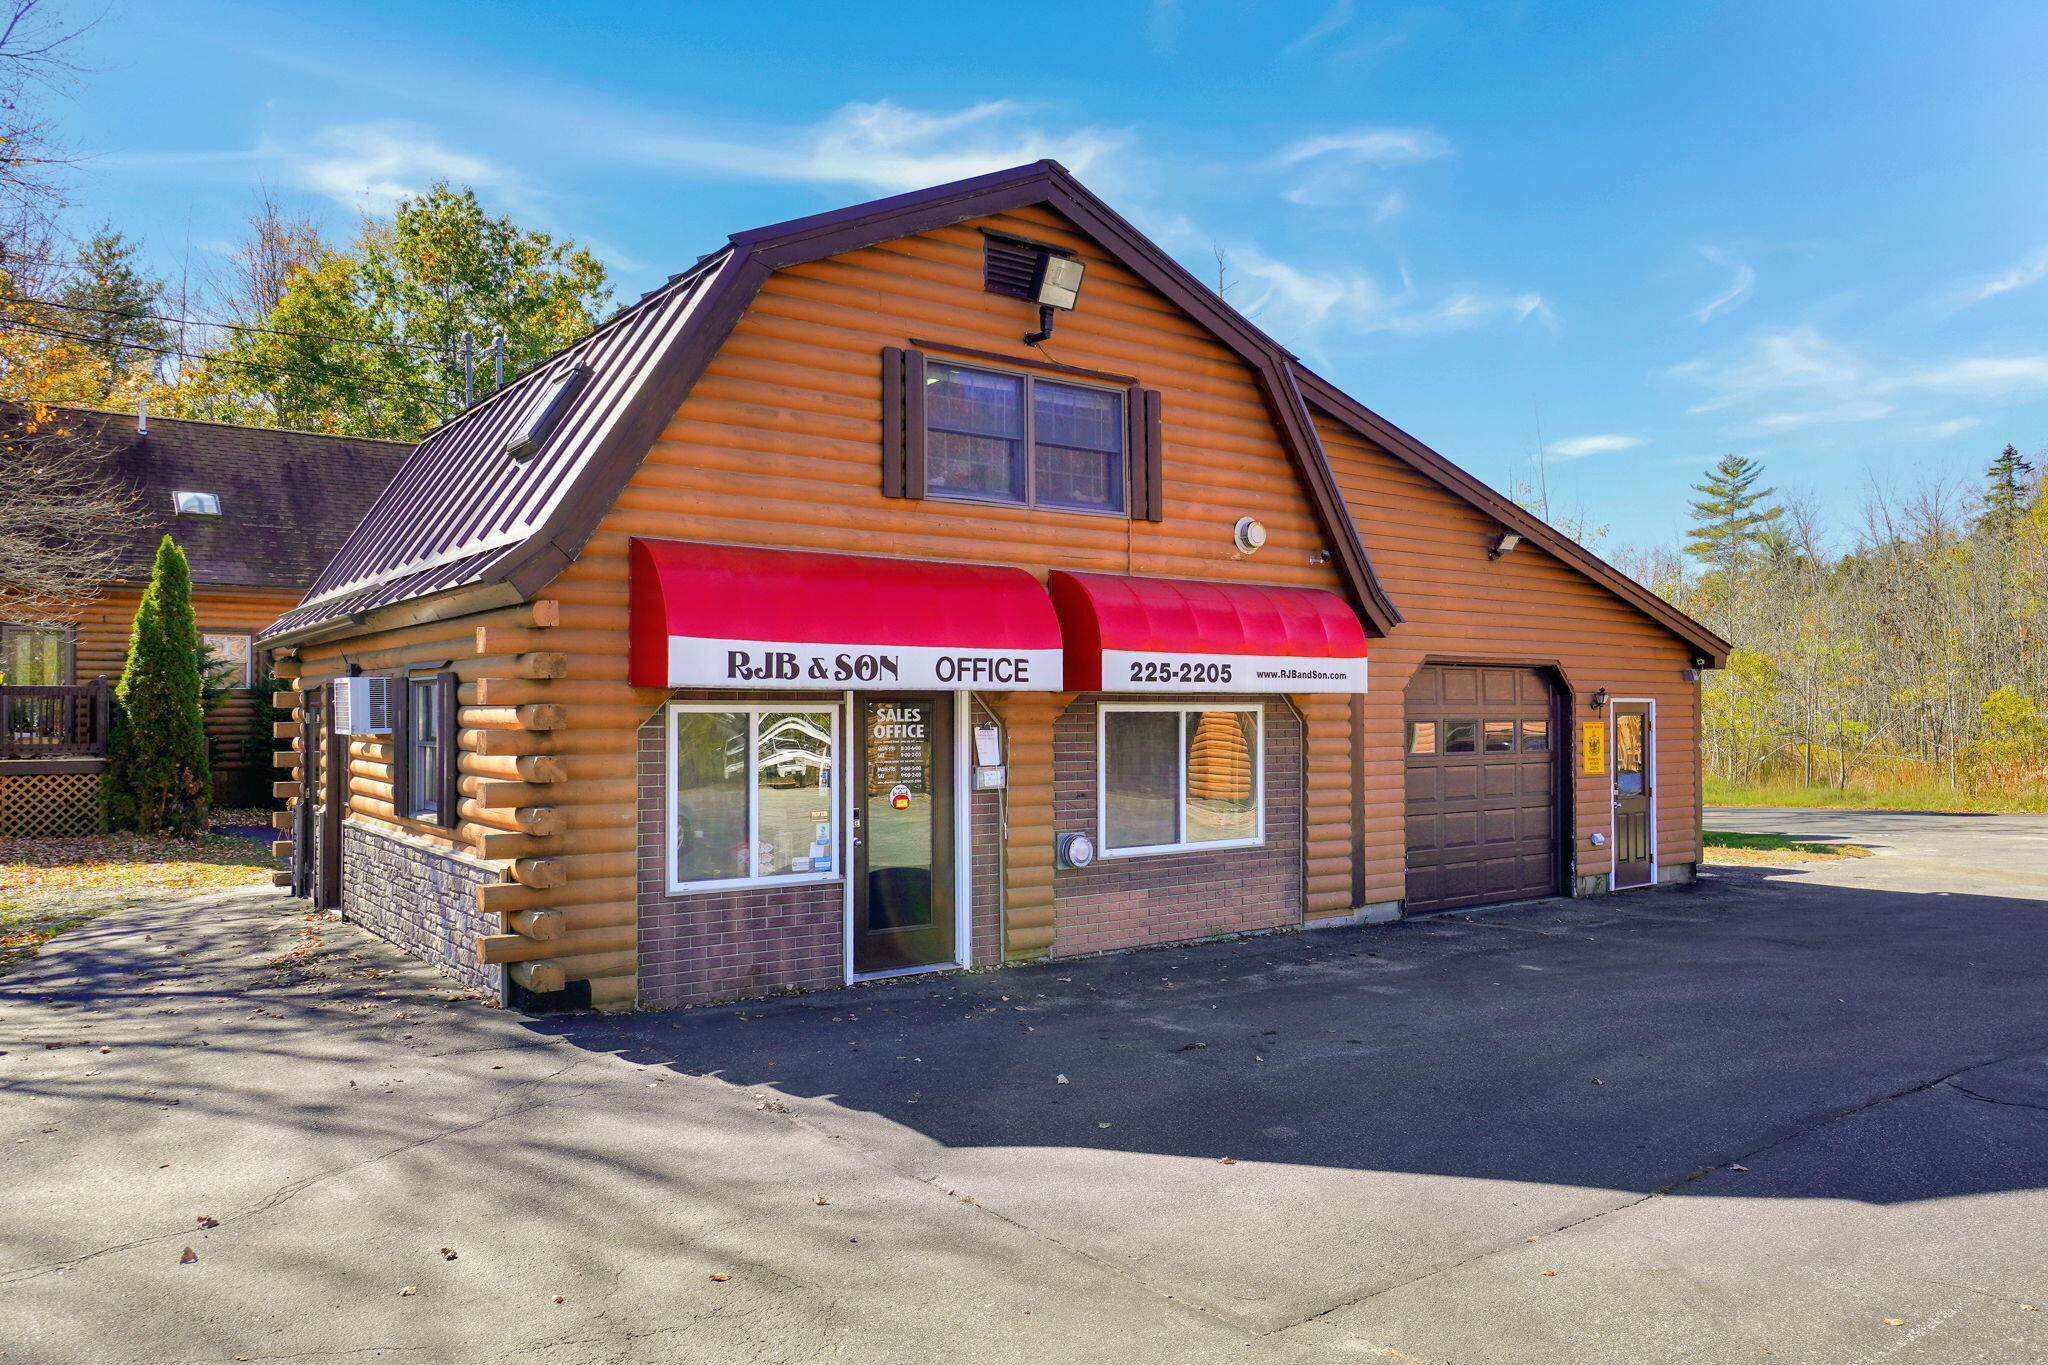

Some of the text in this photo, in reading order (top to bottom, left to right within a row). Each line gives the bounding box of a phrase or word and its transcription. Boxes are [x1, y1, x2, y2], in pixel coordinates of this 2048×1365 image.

[727, 650, 1030, 683] RJB & SON OFFICE
[1130, 661, 1232, 683] 225-2205
[1256, 669, 1347, 680] www.RJBandSon.com
[877, 708, 921, 722] SALES
[873, 724, 925, 738] OFFICE
